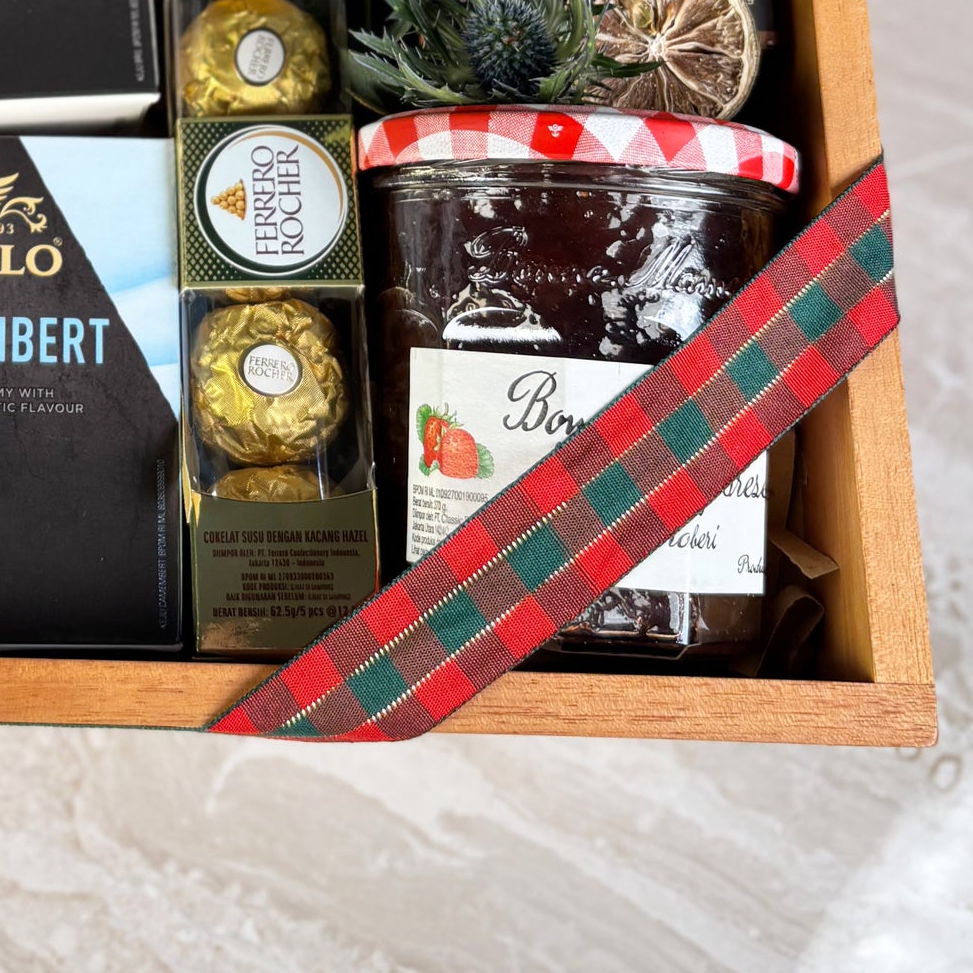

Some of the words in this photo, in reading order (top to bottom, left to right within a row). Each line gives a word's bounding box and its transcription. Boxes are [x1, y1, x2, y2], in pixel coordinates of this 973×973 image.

[250, 144, 280, 256] FERRERO
[276, 144, 305, 255] ROCHER
[249, 355, 296, 373] FERRERO
[247, 365, 294, 382] ROCHER
[17, 387, 54, 399] WITH
[21, 402, 84, 414] FLAVOUR
[203, 530, 239, 544] COKELAT
[241, 530, 265, 543] SUSU
[266, 530, 302, 543] DENGAN
[305, 530, 340, 543] KACANG
[342, 530, 369, 543] HAZEL
[157, 559, 167, 608] CAMEMBERT
[212, 607, 236, 617] BERAT
[270, 606, 306, 619] 62.5g/5
[308, 607, 323, 619] pcs
